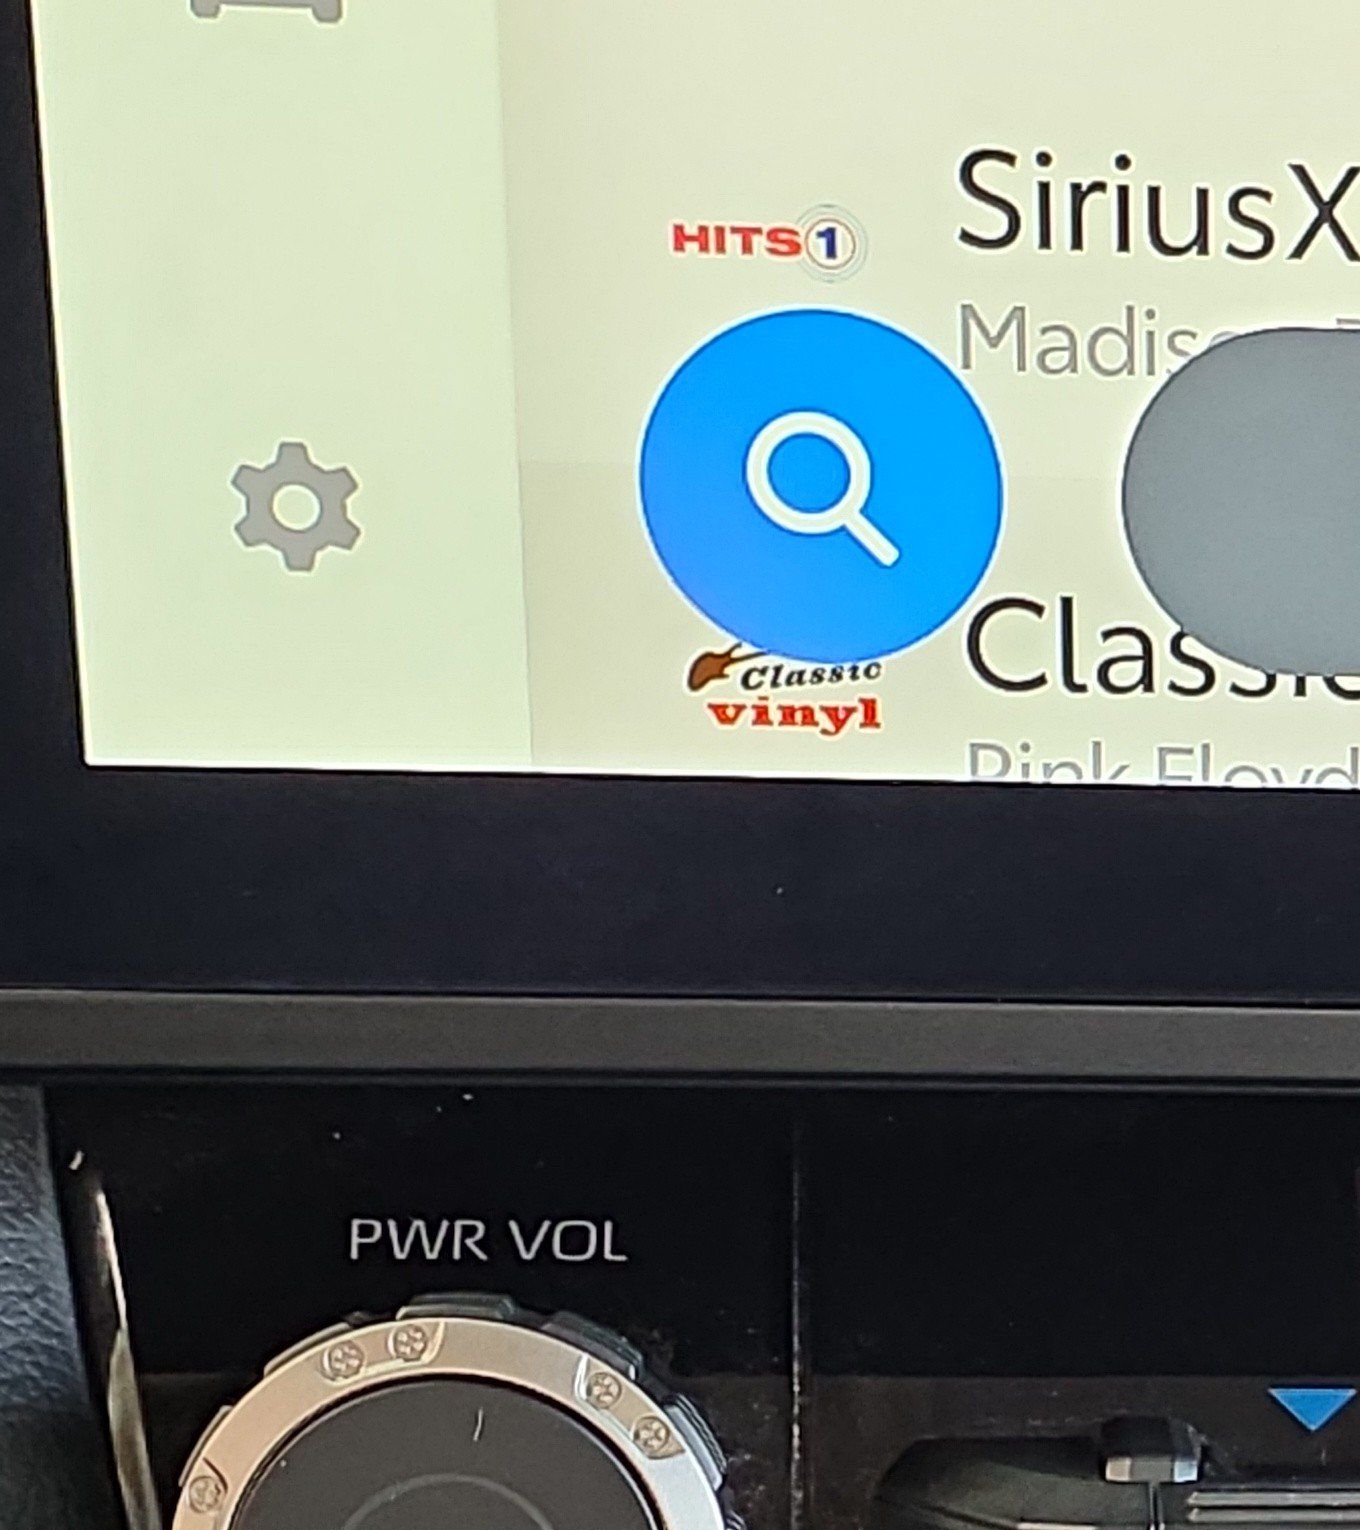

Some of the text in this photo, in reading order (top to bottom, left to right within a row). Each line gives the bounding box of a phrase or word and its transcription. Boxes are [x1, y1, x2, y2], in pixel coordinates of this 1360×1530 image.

[672, 223, 802, 256] HITS
[959, 304, 1237, 377] Madis
[707, 696, 881, 735] vinyl
[350, 1219, 629, 1262] PWR VOL
